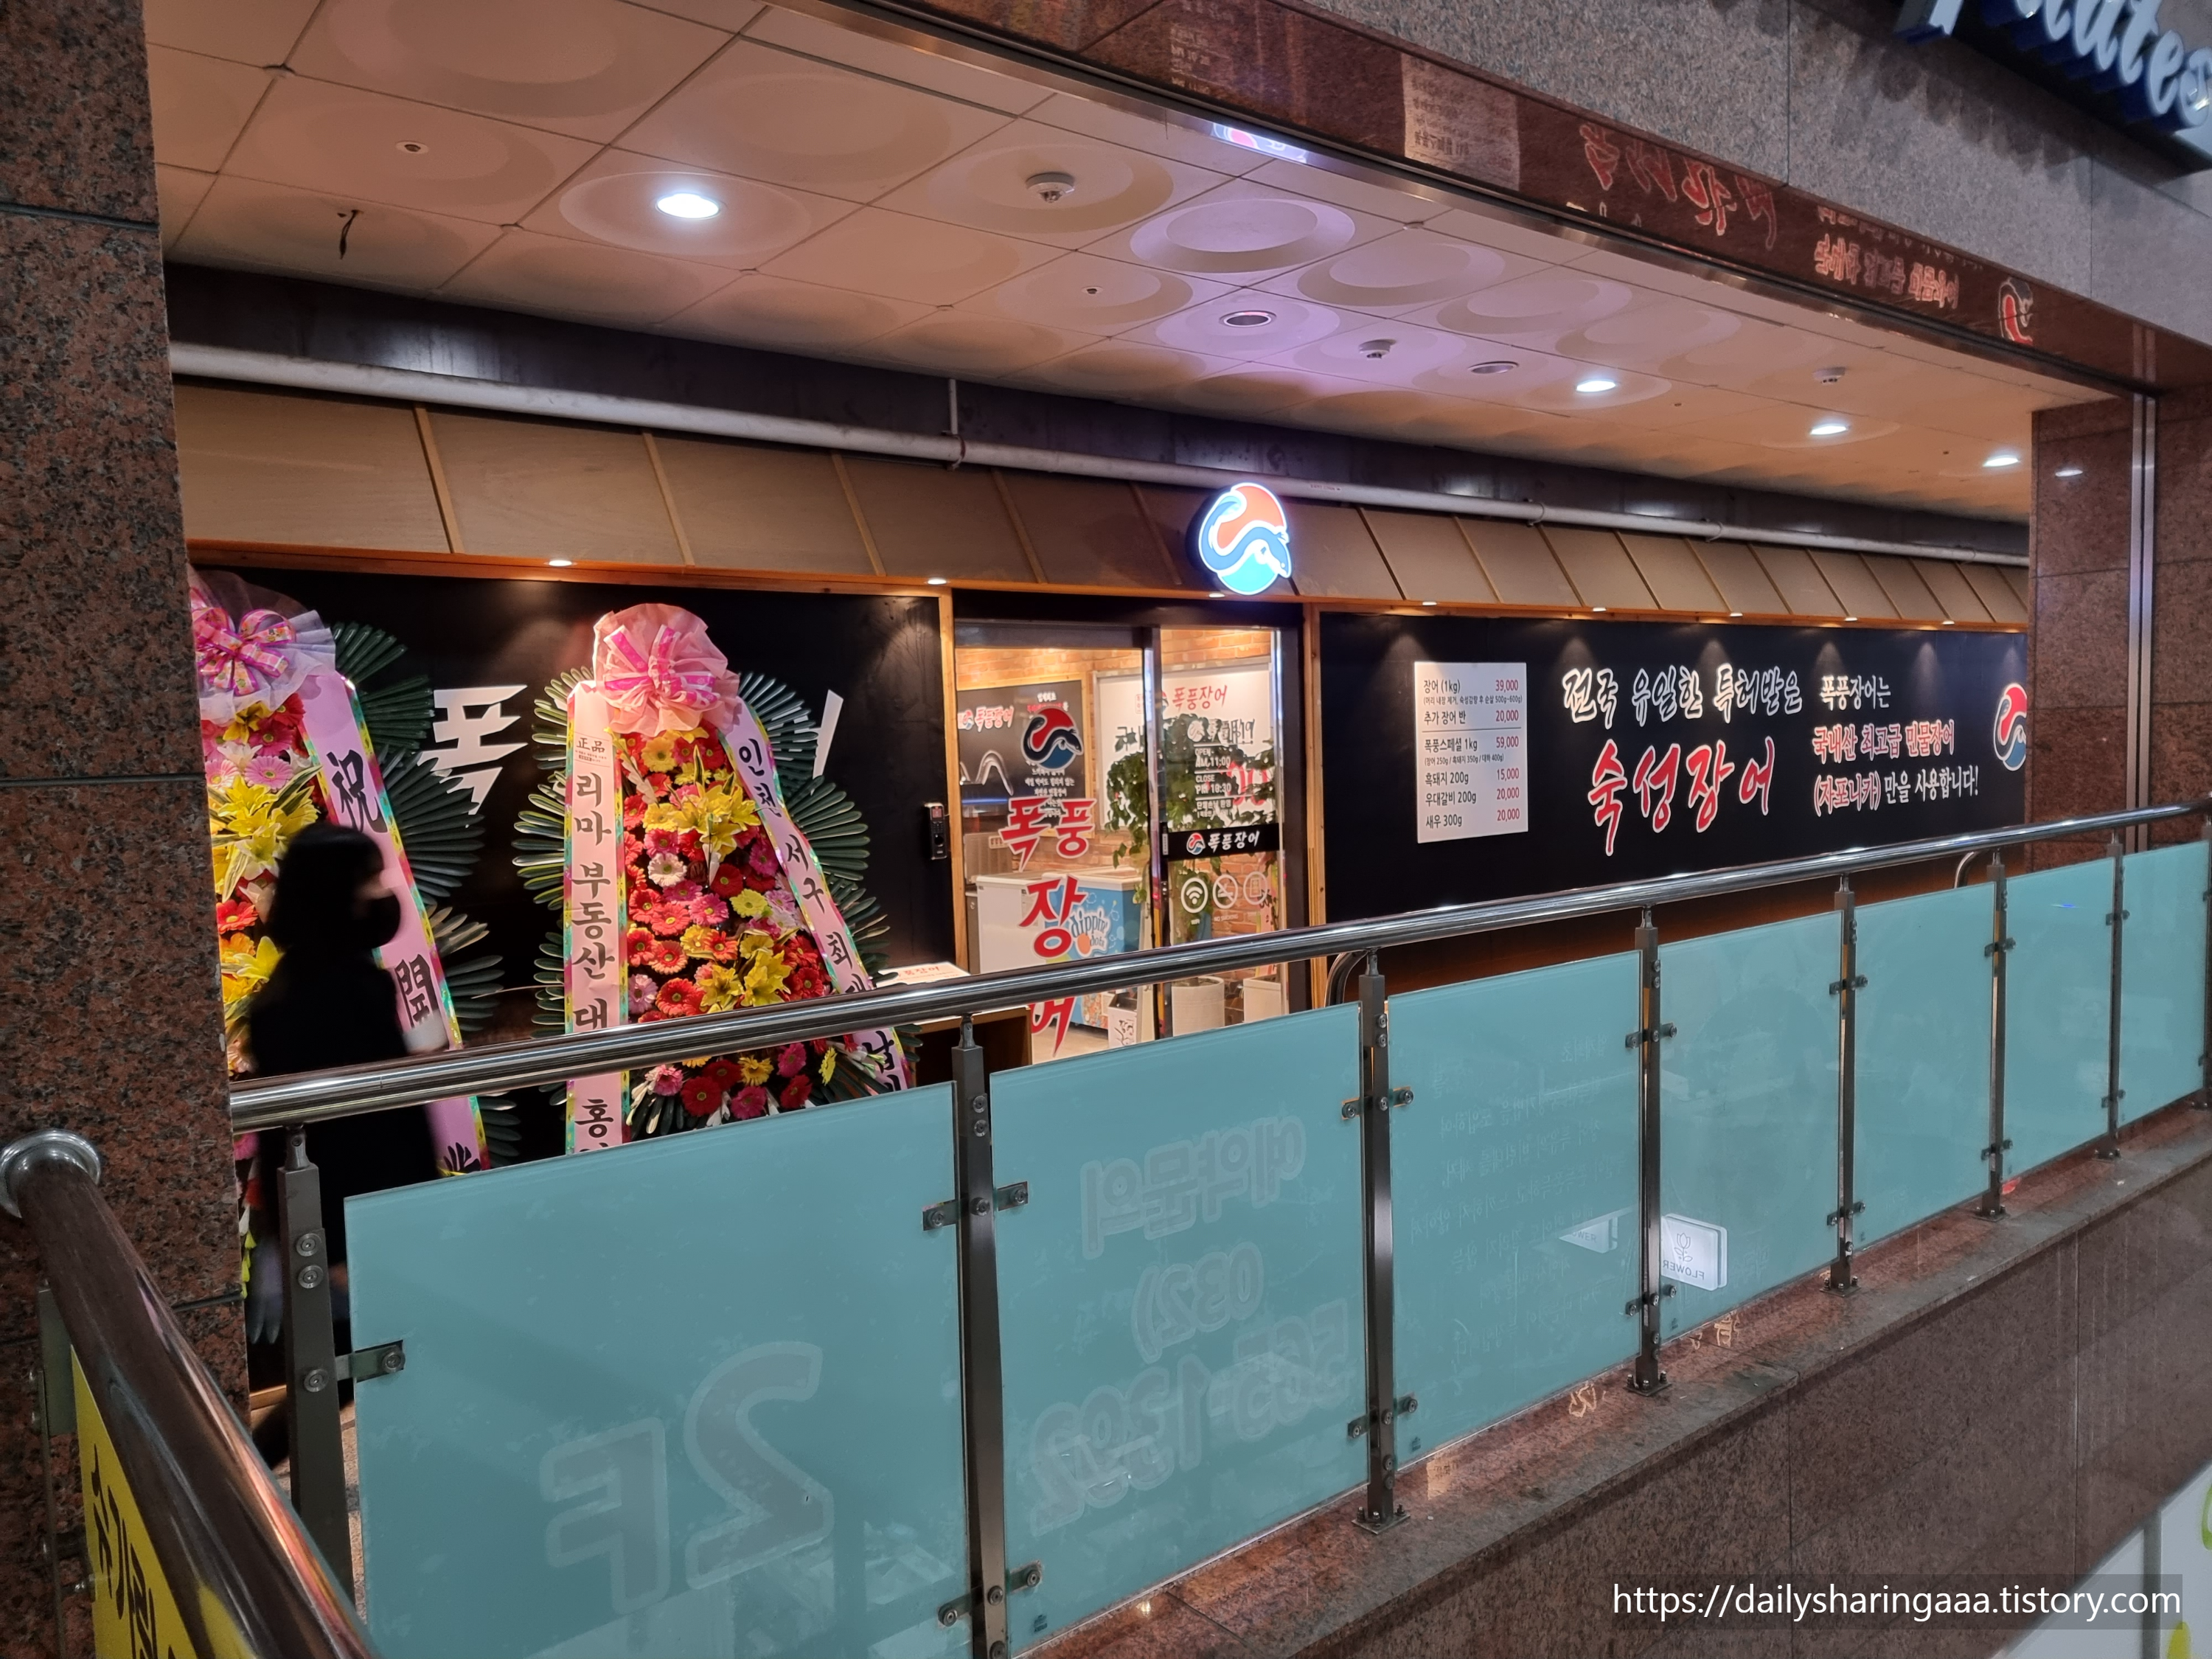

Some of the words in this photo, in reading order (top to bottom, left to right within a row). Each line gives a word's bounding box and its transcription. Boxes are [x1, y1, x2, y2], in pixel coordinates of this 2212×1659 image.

[1423, 679, 1439, 694] 장어
[1441, 679, 1461, 695] (1kg)
[1495, 679, 1519, 693] 39,000
[1820, 674, 1891, 710] 폭풍장어는
[1172, 684, 1228, 712] 폭풍장어
[1436, 696, 1446, 705] 내장
[1562, 667, 1618, 729] 전국
[1632, 664, 1703, 727] 유일한
[1712, 662, 1802, 723] 특허받은
[1424, 711, 1439, 726] 추가
[1441, 711, 1456, 725] 장어
[1458, 710, 1467, 724] 반
[1495, 709, 1519, 723] 20,000
[577, 737, 605, 753] 正品
[1424, 737, 1462, 753] 폭풍스페셜
[1464, 737, 1478, 751] 1kg
[1496, 736, 1519, 749] 59,000
[1812, 723, 1858, 765] 국내산
[1860, 722, 1902, 761] 최고급
[1905, 718, 1955, 757] 민물장어
[1194, 748, 1211, 757] OPEN
[1425, 757, 1436, 766] (장어
[1436, 757, 1449, 765] 250g
[1467, 756, 1478, 764] 350g
[1492, 753, 1504, 762] 400g)
[1195, 757, 1209, 768] AM
[1210, 756, 1231, 768] 11:00
[1195, 774, 1215, 783] CLOSE
[1425, 771, 1447, 787] 흑돼지
[1450, 771, 1470, 785] 200g
[1497, 768, 1520, 782] 15,000
[1195, 784, 1209, 795] PM
[1496, 787, 1520, 801] 20,000
[1587, 735, 1775, 856] 숙성장어
[1814, 771, 1881, 817] (자포니카)
[1884, 771, 1911, 804] 만을
[1914, 765, 1978, 801] 사용합니다!
[1425, 791, 1455, 807] 우대갈비
[1458, 790, 1477, 804] 200g
[1425, 815, 1441, 830] 새우
[1443, 814, 1462, 827] 300g
[1497, 808, 1520, 822] 20,000
[739, 738, 782, 817] 인천
[786, 834, 825, 914] 서구
[998, 796, 1096, 873] 폭풍
[1208, 830, 1260, 853] 폭풍장어
[571, 862, 616, 981] 부동산
